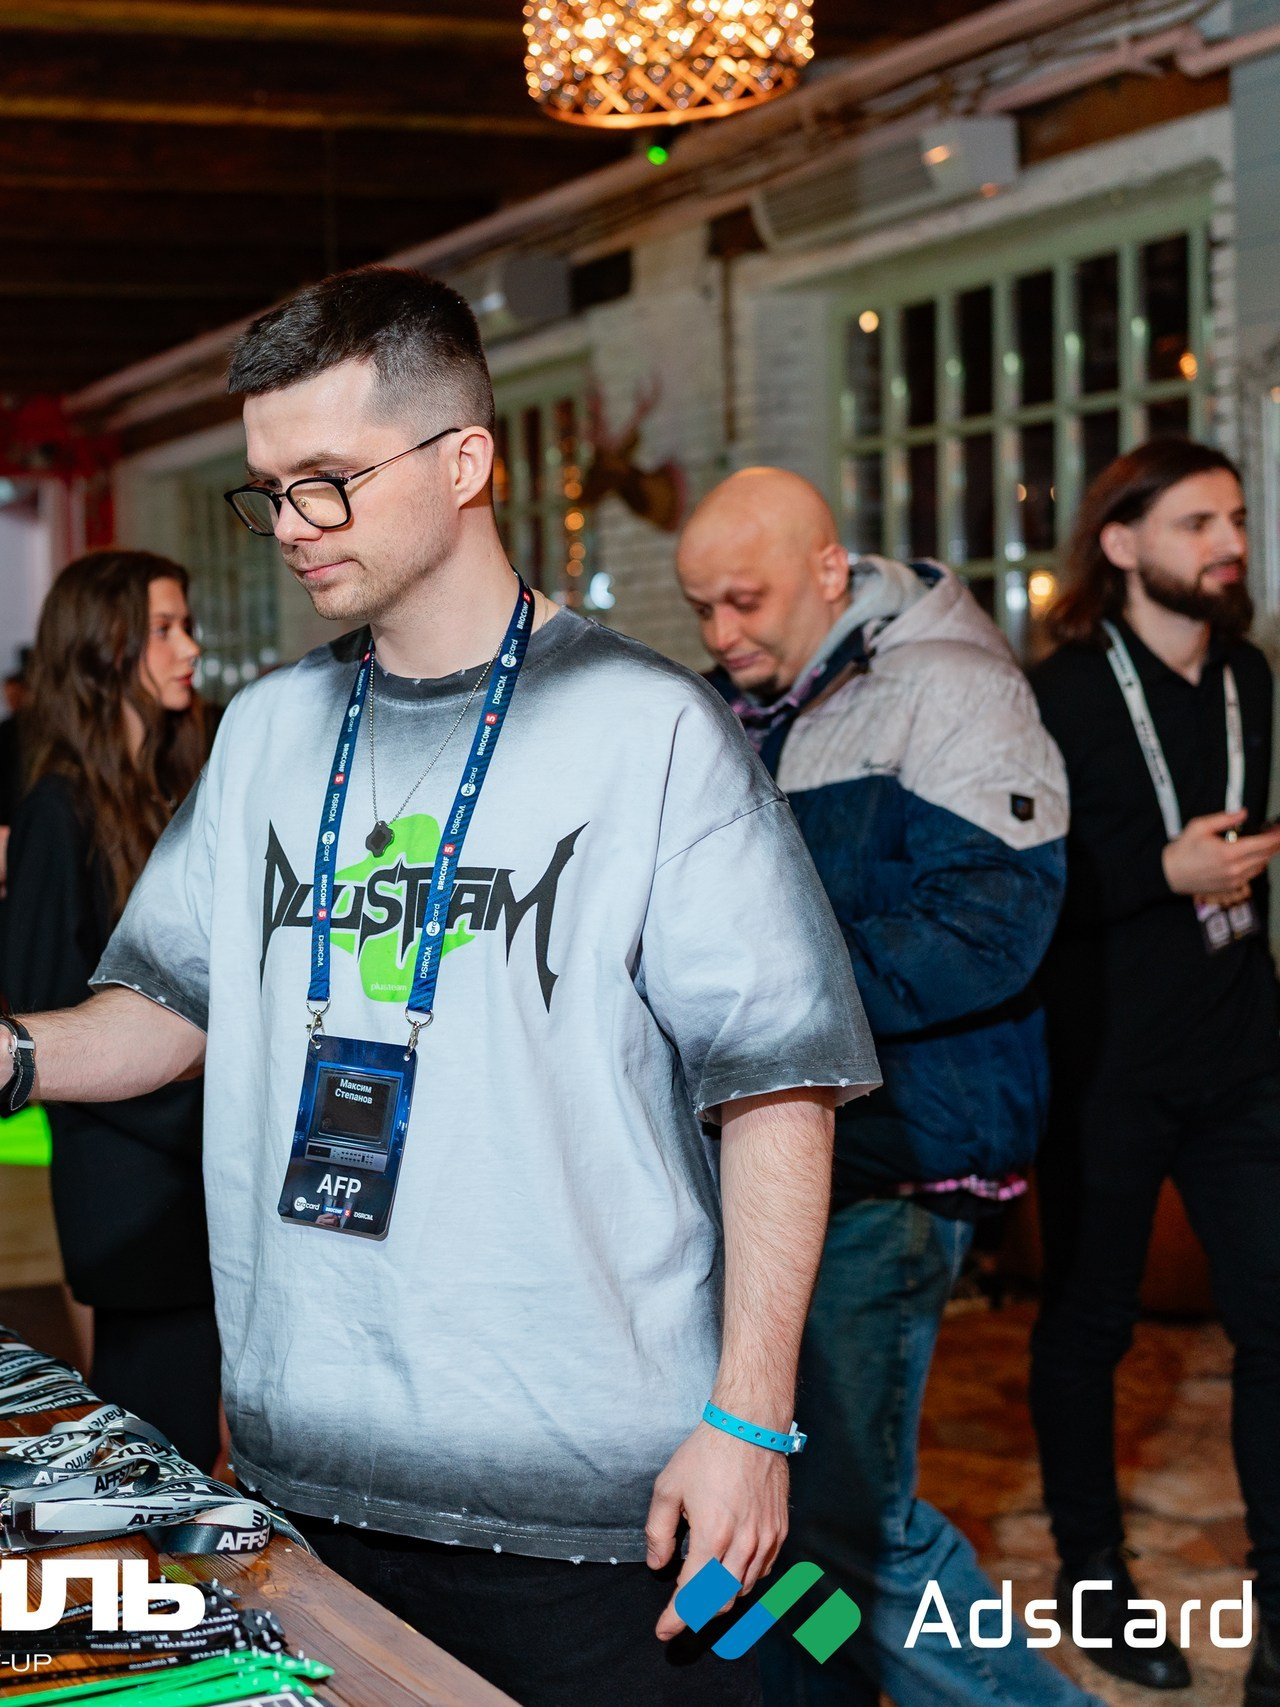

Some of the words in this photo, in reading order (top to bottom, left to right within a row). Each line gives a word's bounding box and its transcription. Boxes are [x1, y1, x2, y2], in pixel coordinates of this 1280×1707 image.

[339, 743, 350, 772] BROCONF
[427, 904, 440, 936] brocard
[437, 857, 449, 890] BROCONF
[462, 767, 478, 796] brocard
[477, 725, 492, 756] BROCONF
[503, 639, 518, 667] brocard
[517, 601, 529, 630] BROCONF
[323, 831, 334, 862] brocard
[335, 1088, 373, 1104] Степанов
[340, 1079, 372, 1093] Максим
[316, 1173, 362, 1199] AFP
[295, 1198, 320, 1211] brocard
